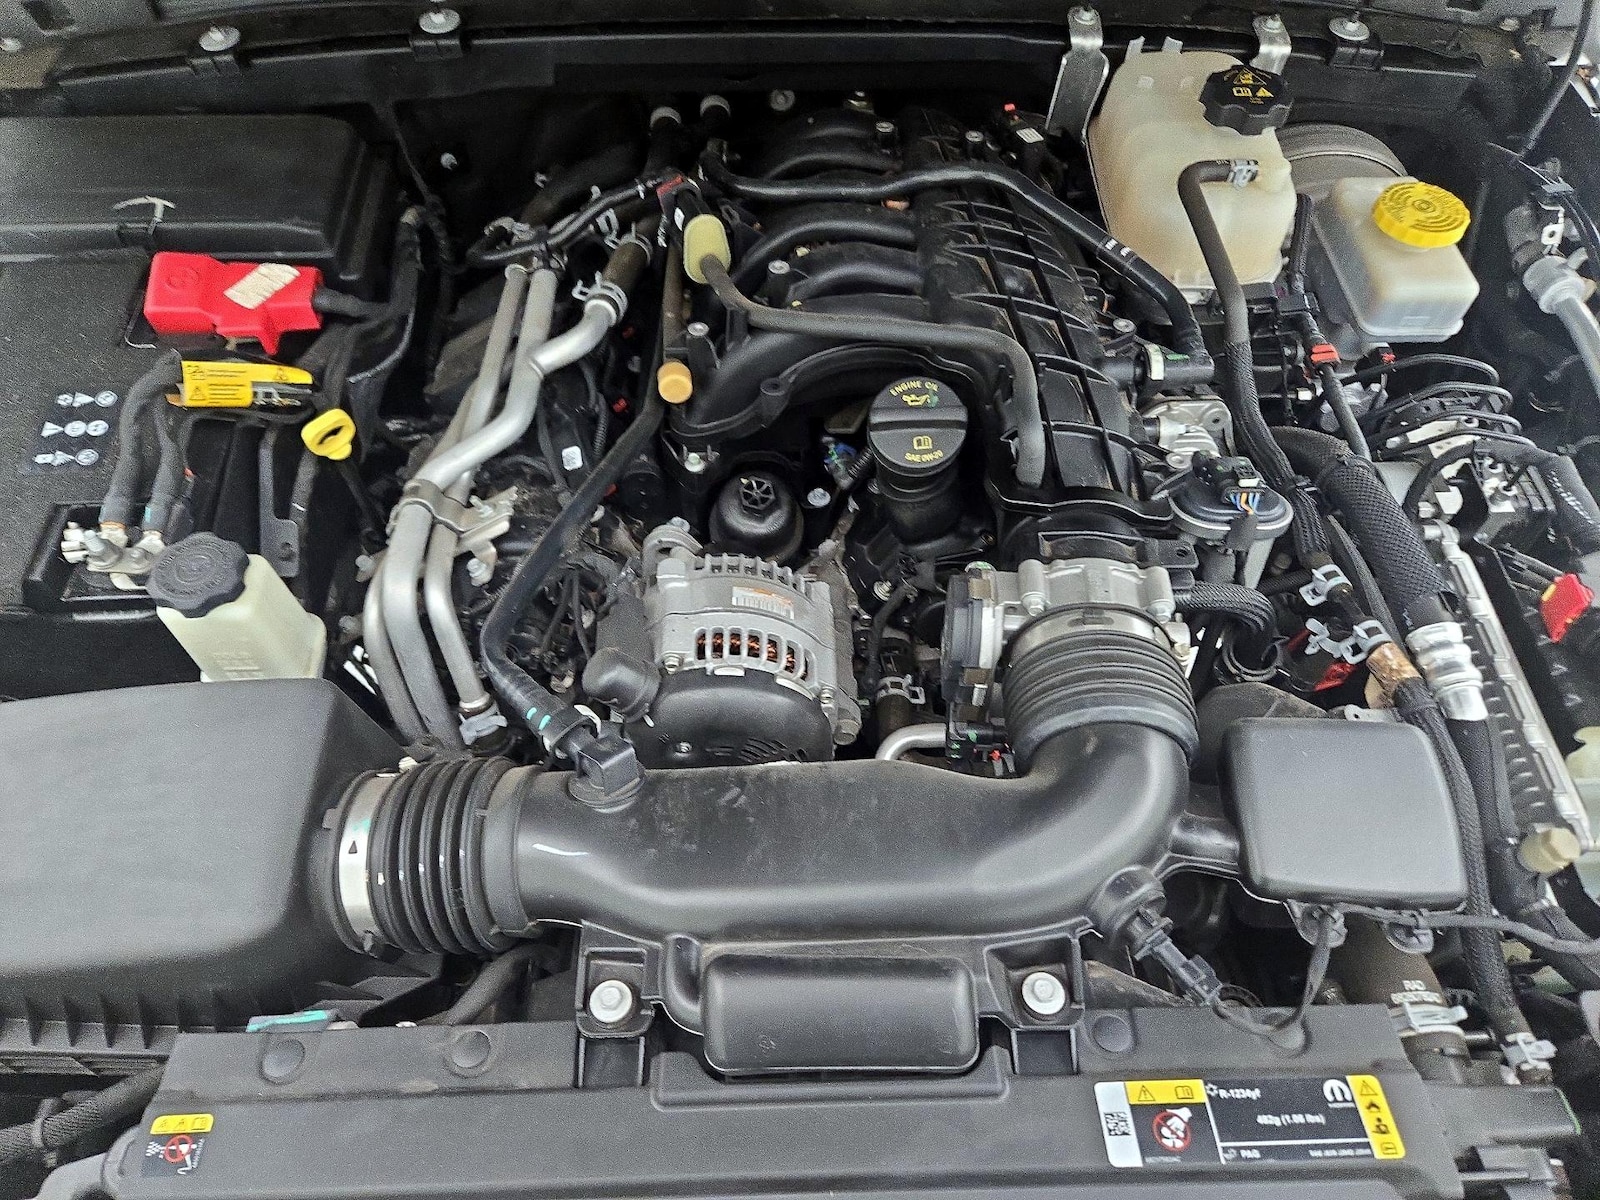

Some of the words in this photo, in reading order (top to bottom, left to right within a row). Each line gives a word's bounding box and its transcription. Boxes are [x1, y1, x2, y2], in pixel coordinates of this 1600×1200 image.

[889, 380, 922, 397] ENGINE
[924, 381, 939, 392] OIL
[904, 452, 922, 462] SAE
[1402, 979, 1427, 991] RAD
